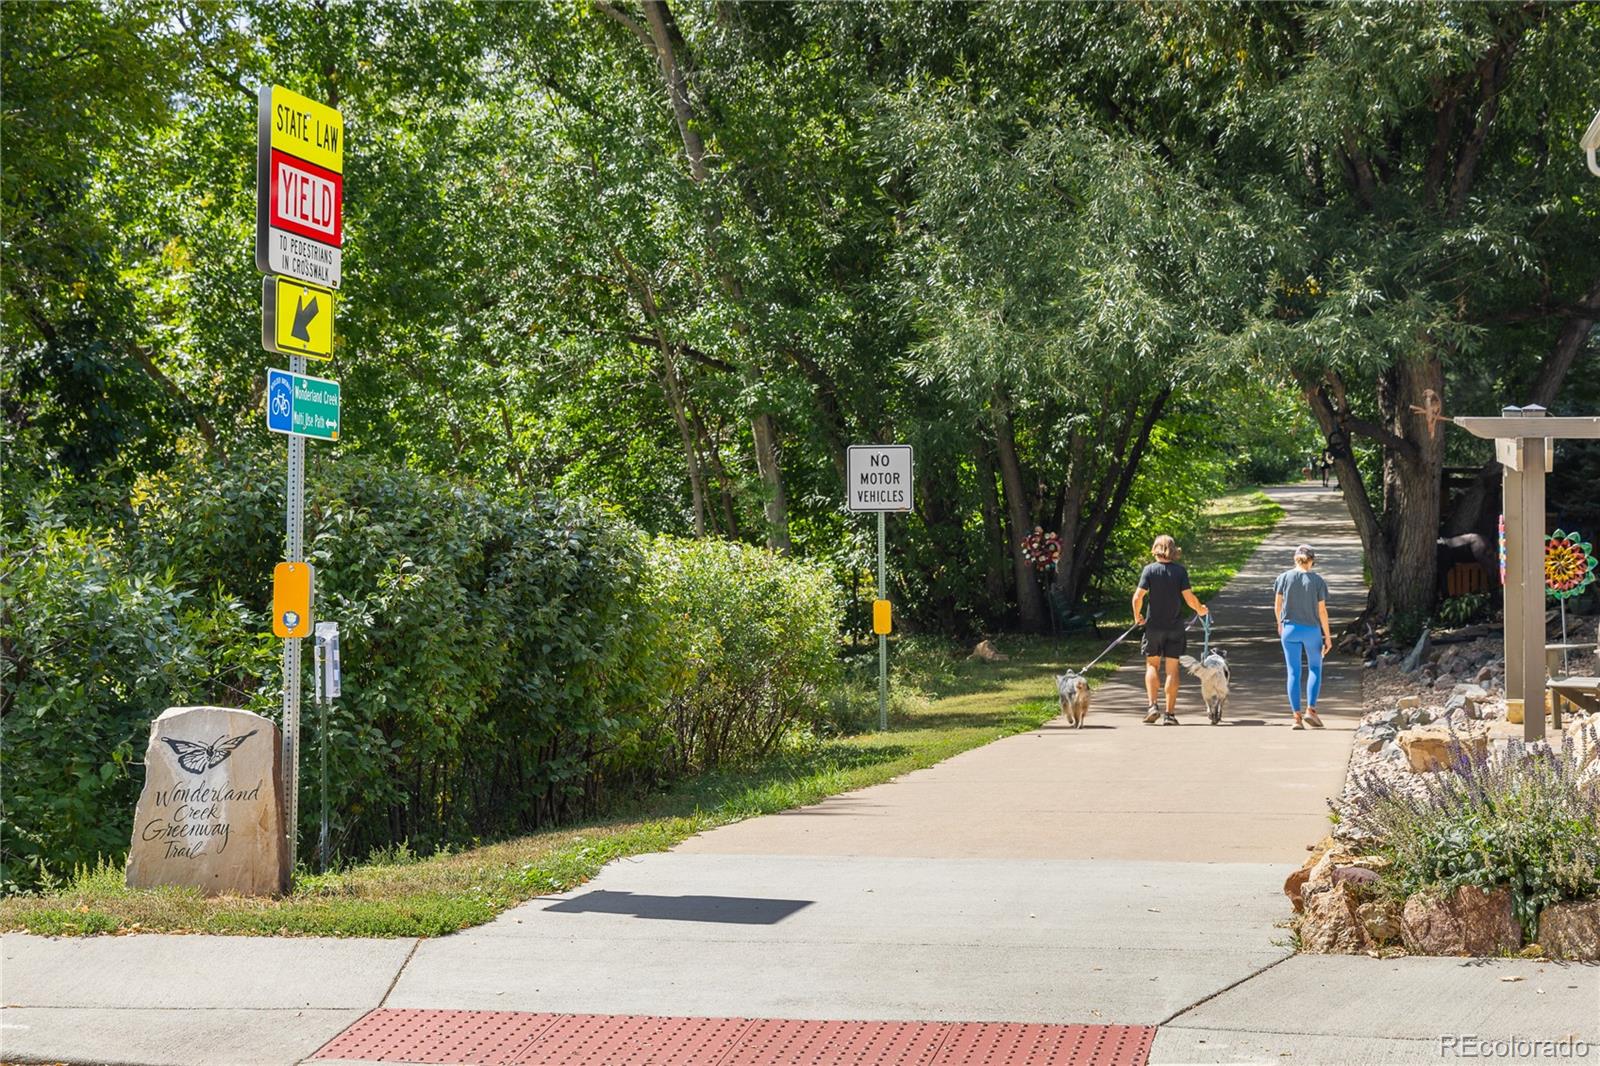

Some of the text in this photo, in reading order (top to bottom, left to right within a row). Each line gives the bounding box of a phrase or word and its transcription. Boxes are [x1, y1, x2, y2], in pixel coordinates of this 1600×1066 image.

[277, 103, 339, 154] STATE LAW
[281, 168, 332, 228] YIELD
[279, 234, 333, 265] TO PEDESTRIANS
[281, 254, 330, 282] IN CROSSWALK
[294, 385, 322, 404] Wonderland
[323, 391, 338, 406] Creek
[314, 414, 325, 429] Path
[870, 454, 890, 467] NO
[860, 472, 900, 485] MOTOR
[857, 490, 904, 503] VEHICLES
[156, 779, 263, 807] Wonderland
[173, 803, 221, 823] Creek
[142, 818, 235, 855] Greenway
[164, 840, 207, 860] Trail
